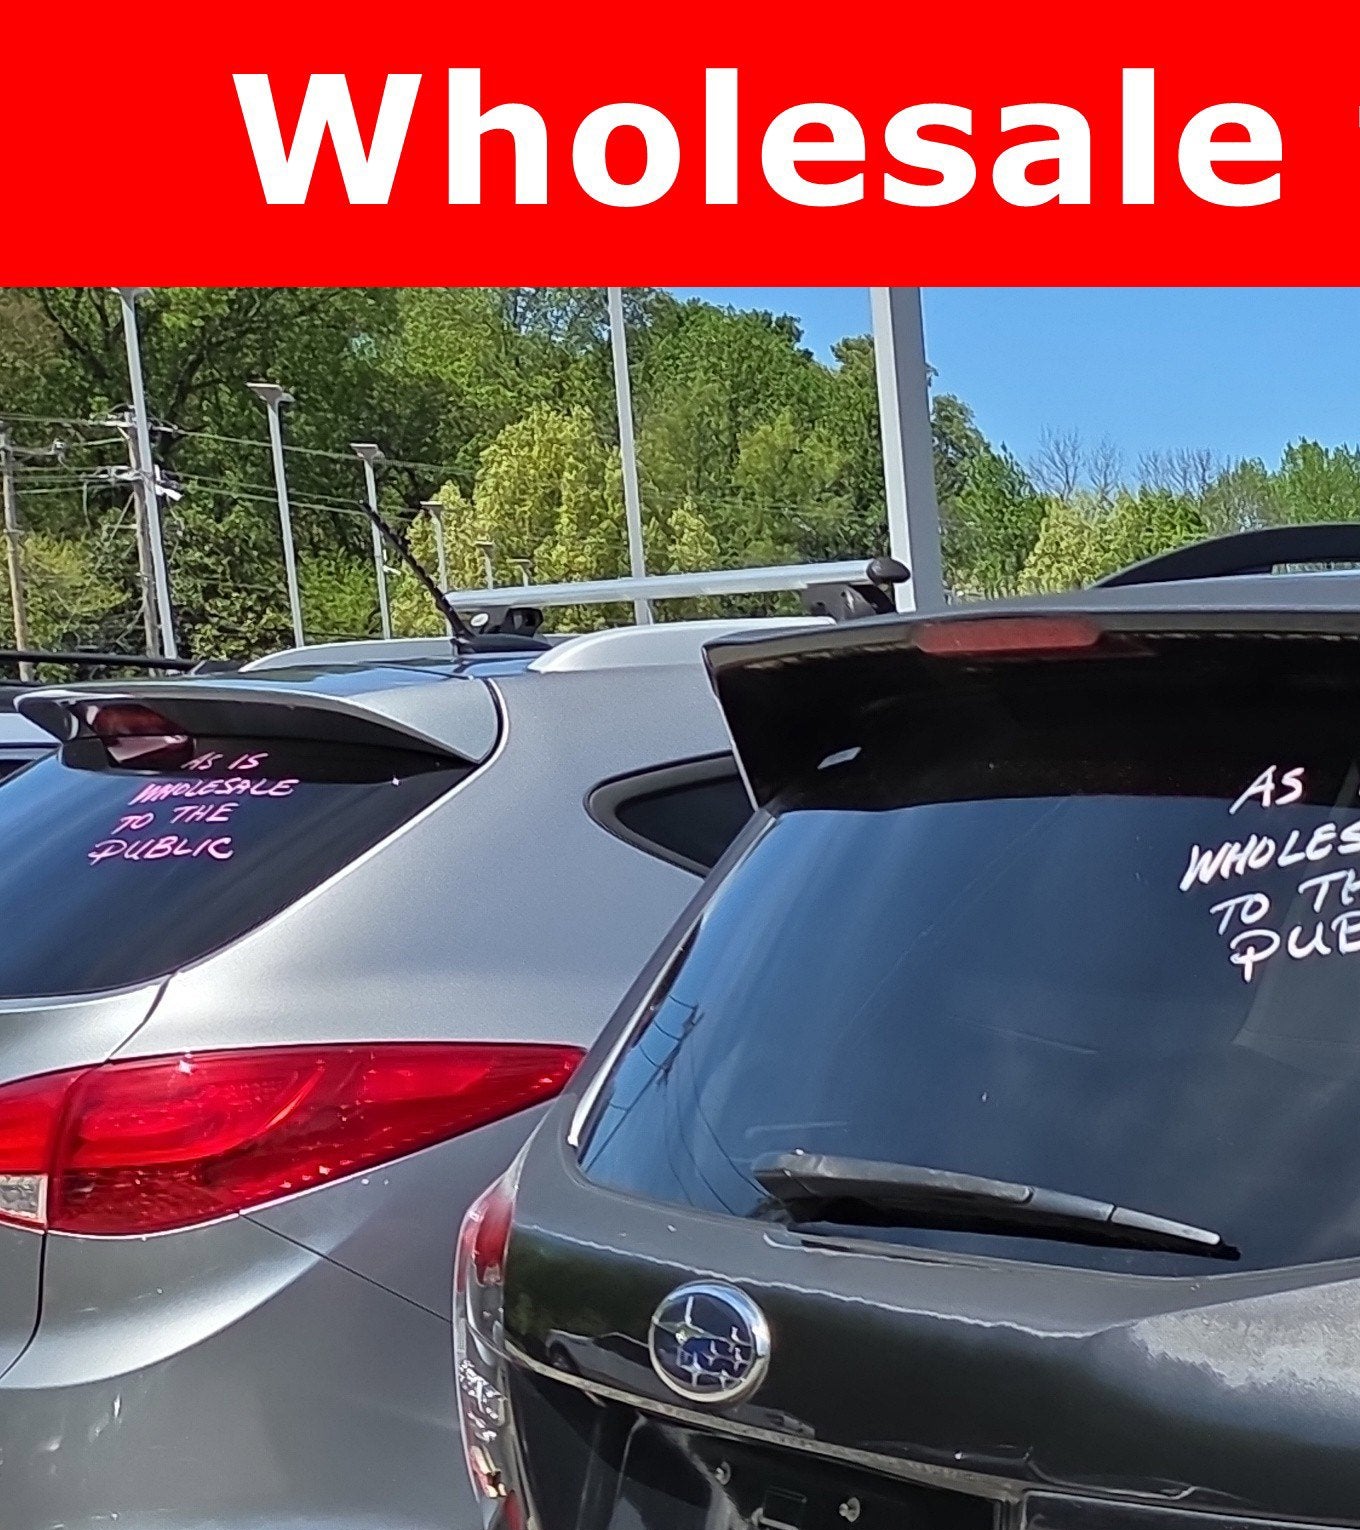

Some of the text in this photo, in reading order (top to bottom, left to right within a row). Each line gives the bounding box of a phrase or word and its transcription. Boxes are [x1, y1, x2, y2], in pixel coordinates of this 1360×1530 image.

[181, 751, 269, 771] AS IS
[127, 776, 300, 806] WHOLESALE
[1228, 764, 1306, 815] AS
[111, 801, 240, 835] TO THE
[87, 834, 234, 867] PUBLIC
[1208, 892, 1271, 937] TO
